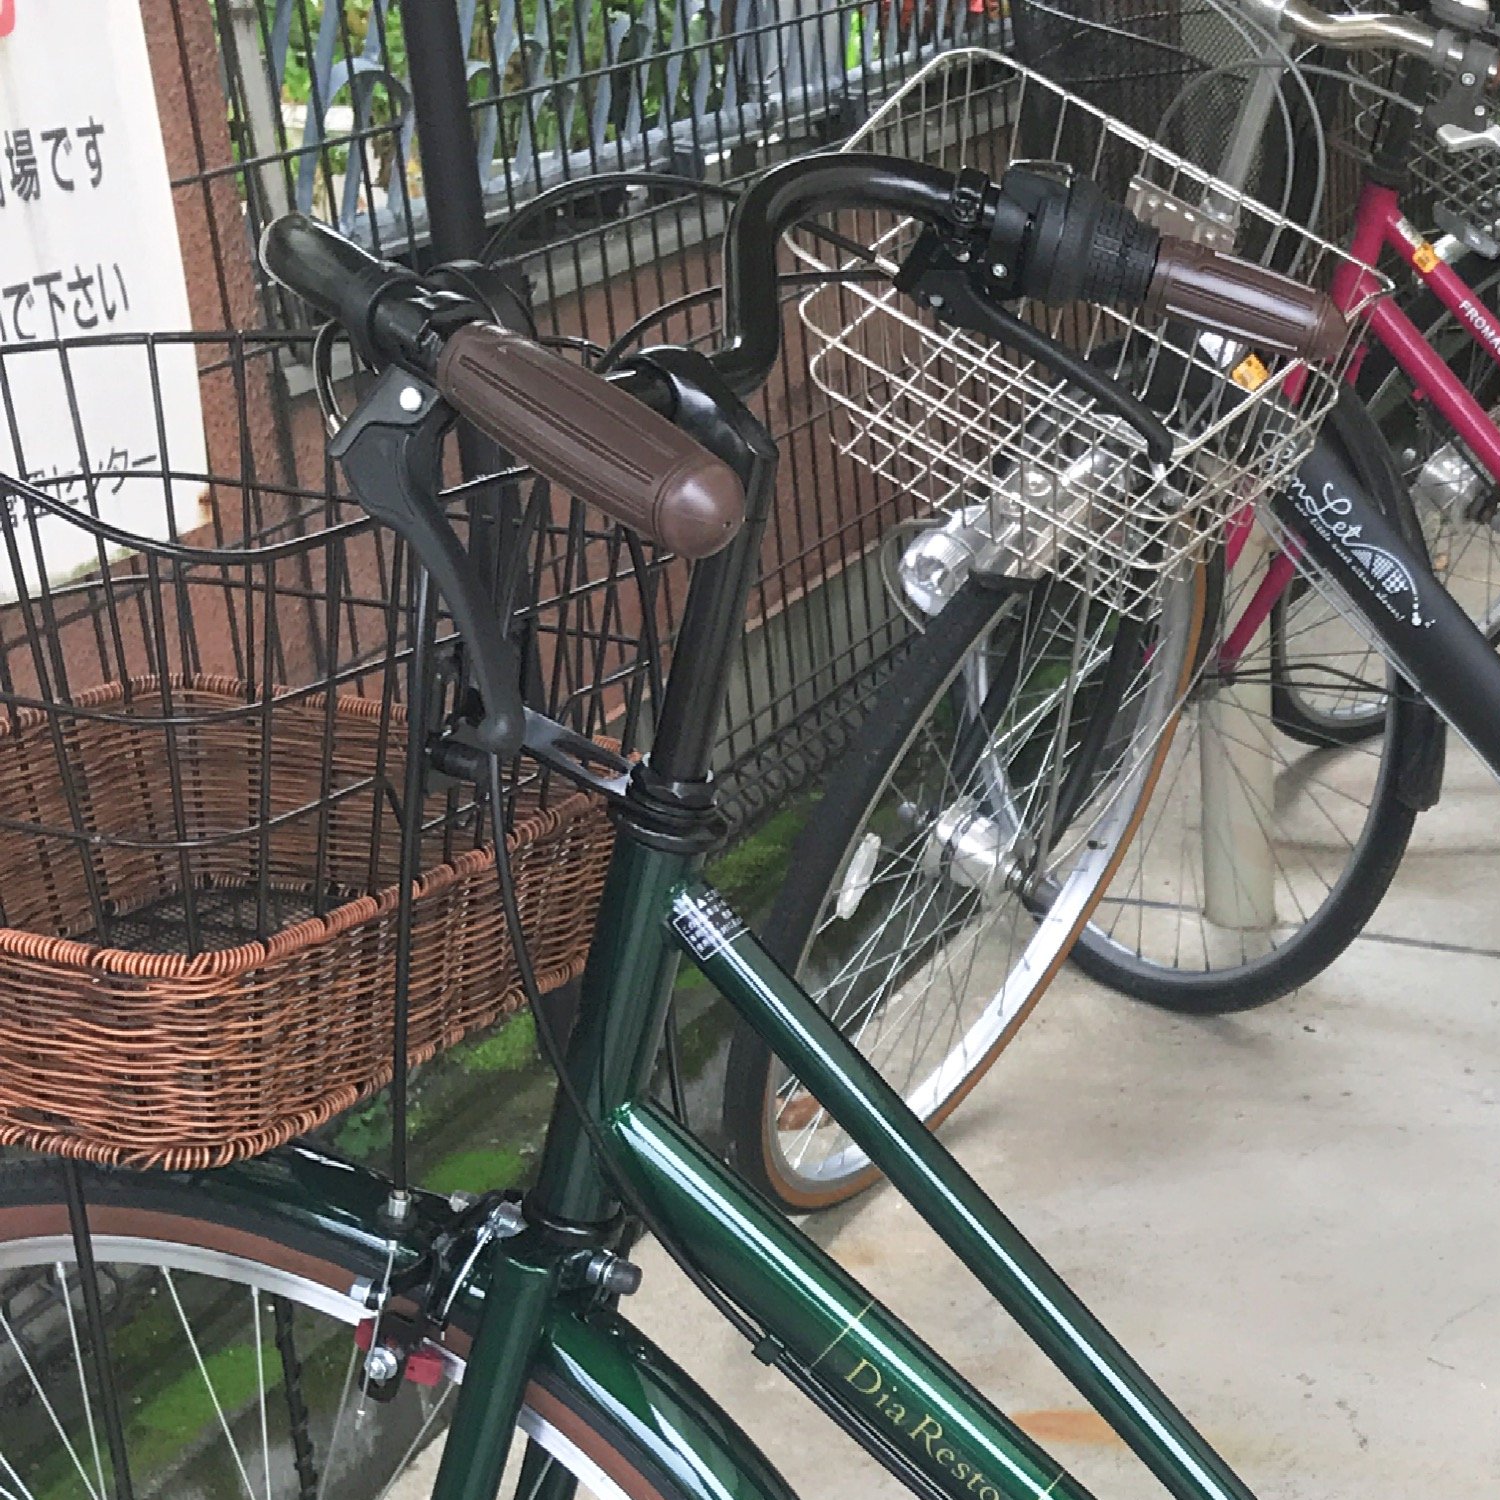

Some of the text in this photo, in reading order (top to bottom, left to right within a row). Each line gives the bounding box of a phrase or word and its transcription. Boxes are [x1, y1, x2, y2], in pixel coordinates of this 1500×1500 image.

[0, 116, 105, 206] 場です
[0, 263, 129, 345] で下さい
[844, 1358, 906, 1425] Dia
